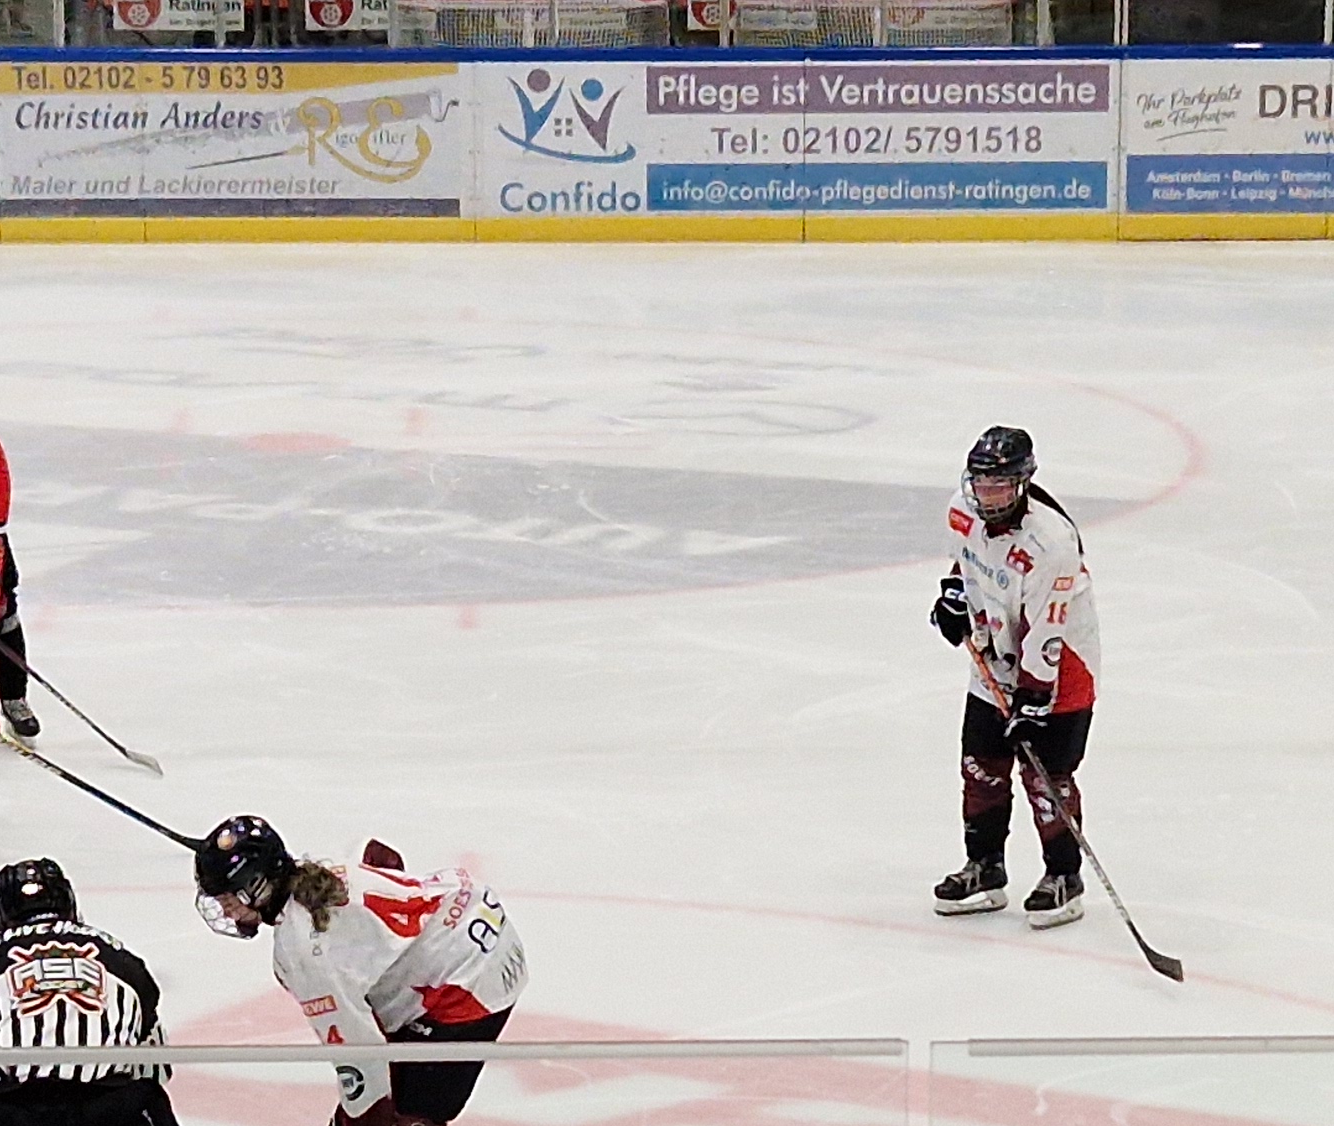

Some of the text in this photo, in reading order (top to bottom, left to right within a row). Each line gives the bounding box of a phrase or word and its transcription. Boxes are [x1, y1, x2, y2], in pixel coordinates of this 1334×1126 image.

[15, 66, 50, 91] Tel.
[63, 66, 136, 90] 02102
[161, 66, 175, 89] 5
[184, 66, 211, 89] 79
[220, 66, 248, 89] 63
[257, 66, 285, 89] 93
[658, 74, 1098, 112] Pflege ist Vertrauenssache
[15, 101, 265, 132] Christian Anders
[711, 126, 1043, 155] Tel: 02102/ 5791518
[11, 174, 341, 196] Maler und Lackierermeister
[500, 181, 641, 213] Confido
[662, 177, 1092, 205] info@confido-pflegedienst-ratingen.de
